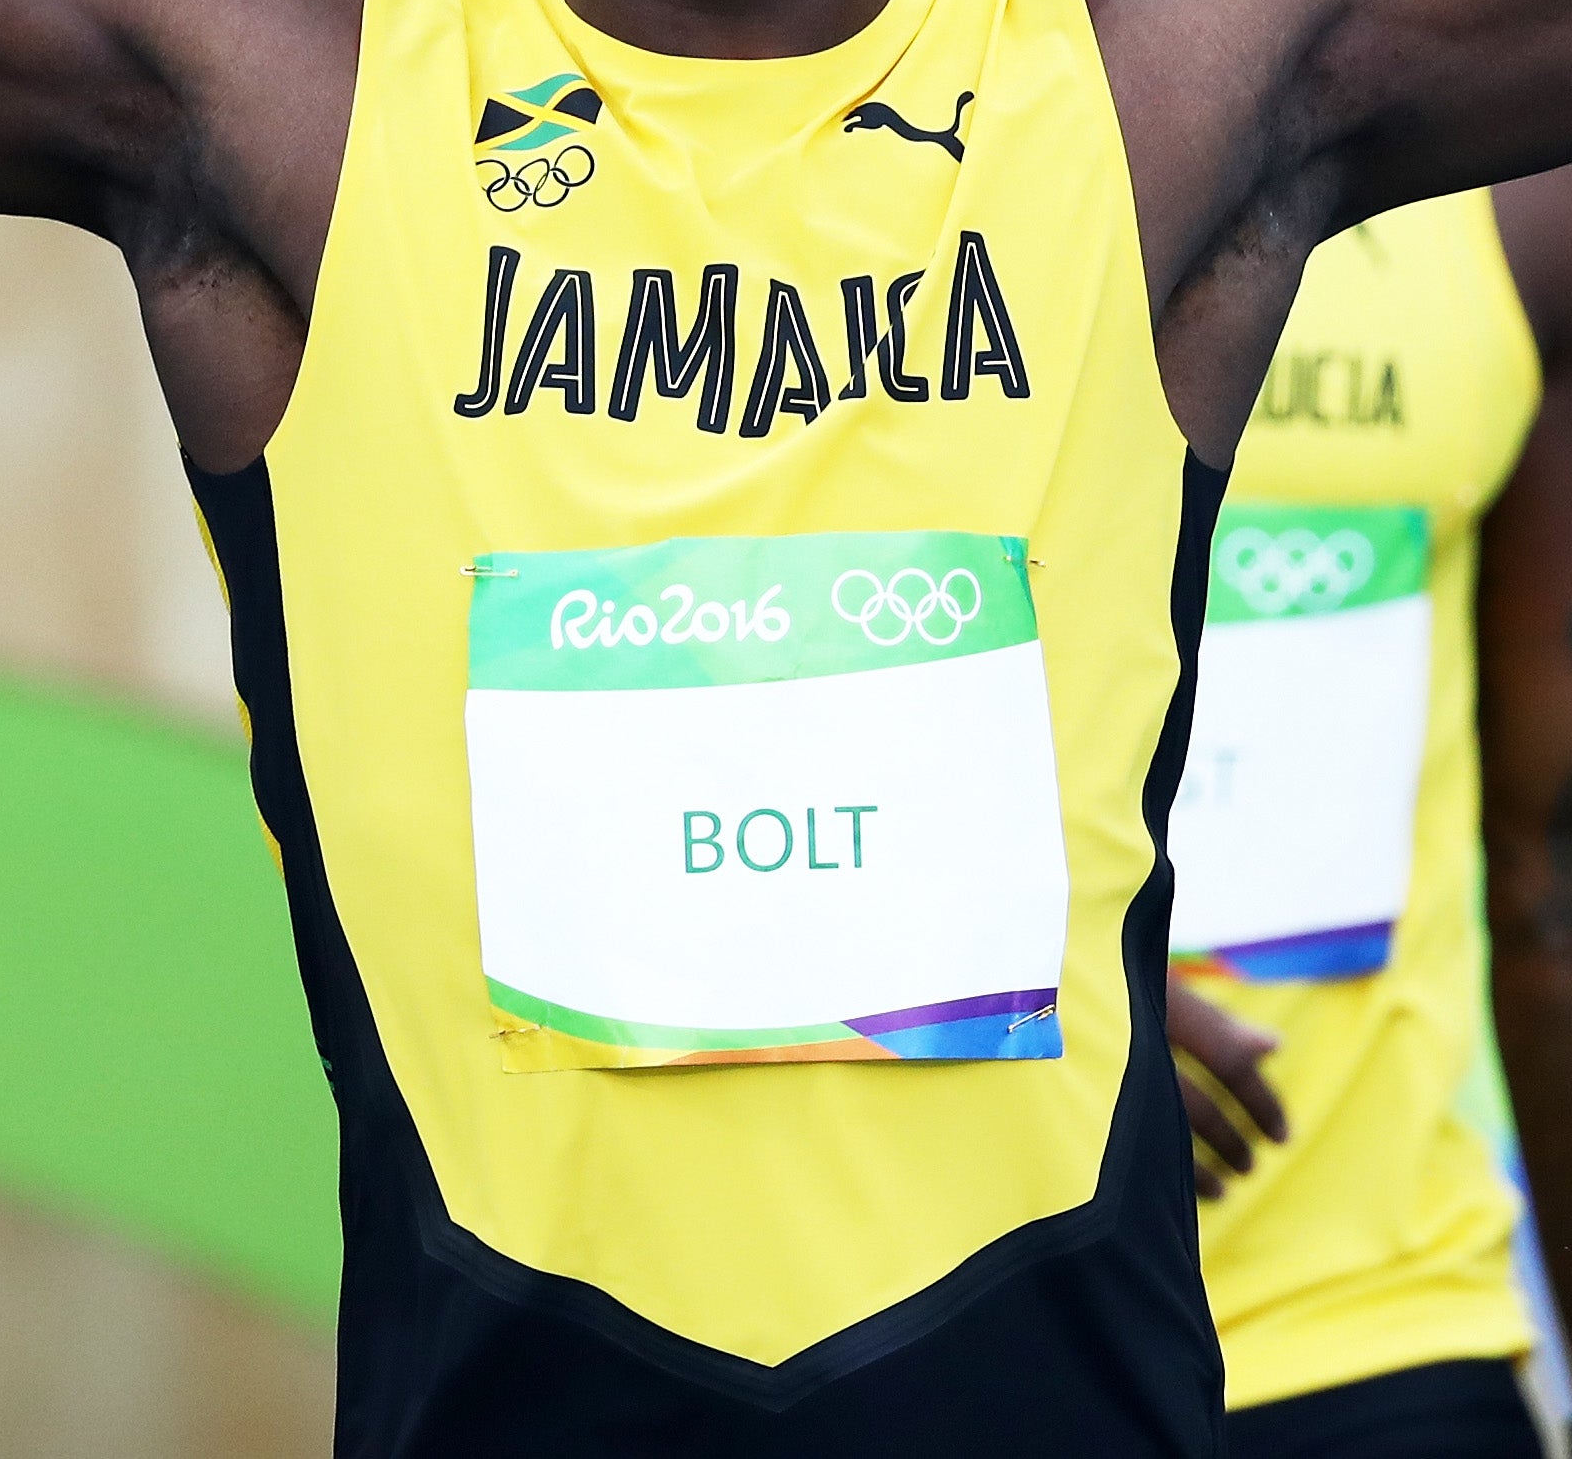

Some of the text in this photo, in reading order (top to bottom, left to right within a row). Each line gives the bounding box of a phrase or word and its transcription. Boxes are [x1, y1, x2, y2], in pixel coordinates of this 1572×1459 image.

[453, 230, 1031, 439] JAMAICA
[1251, 352, 1405, 426] UCIA
[682, 805, 878, 874] BOLT
